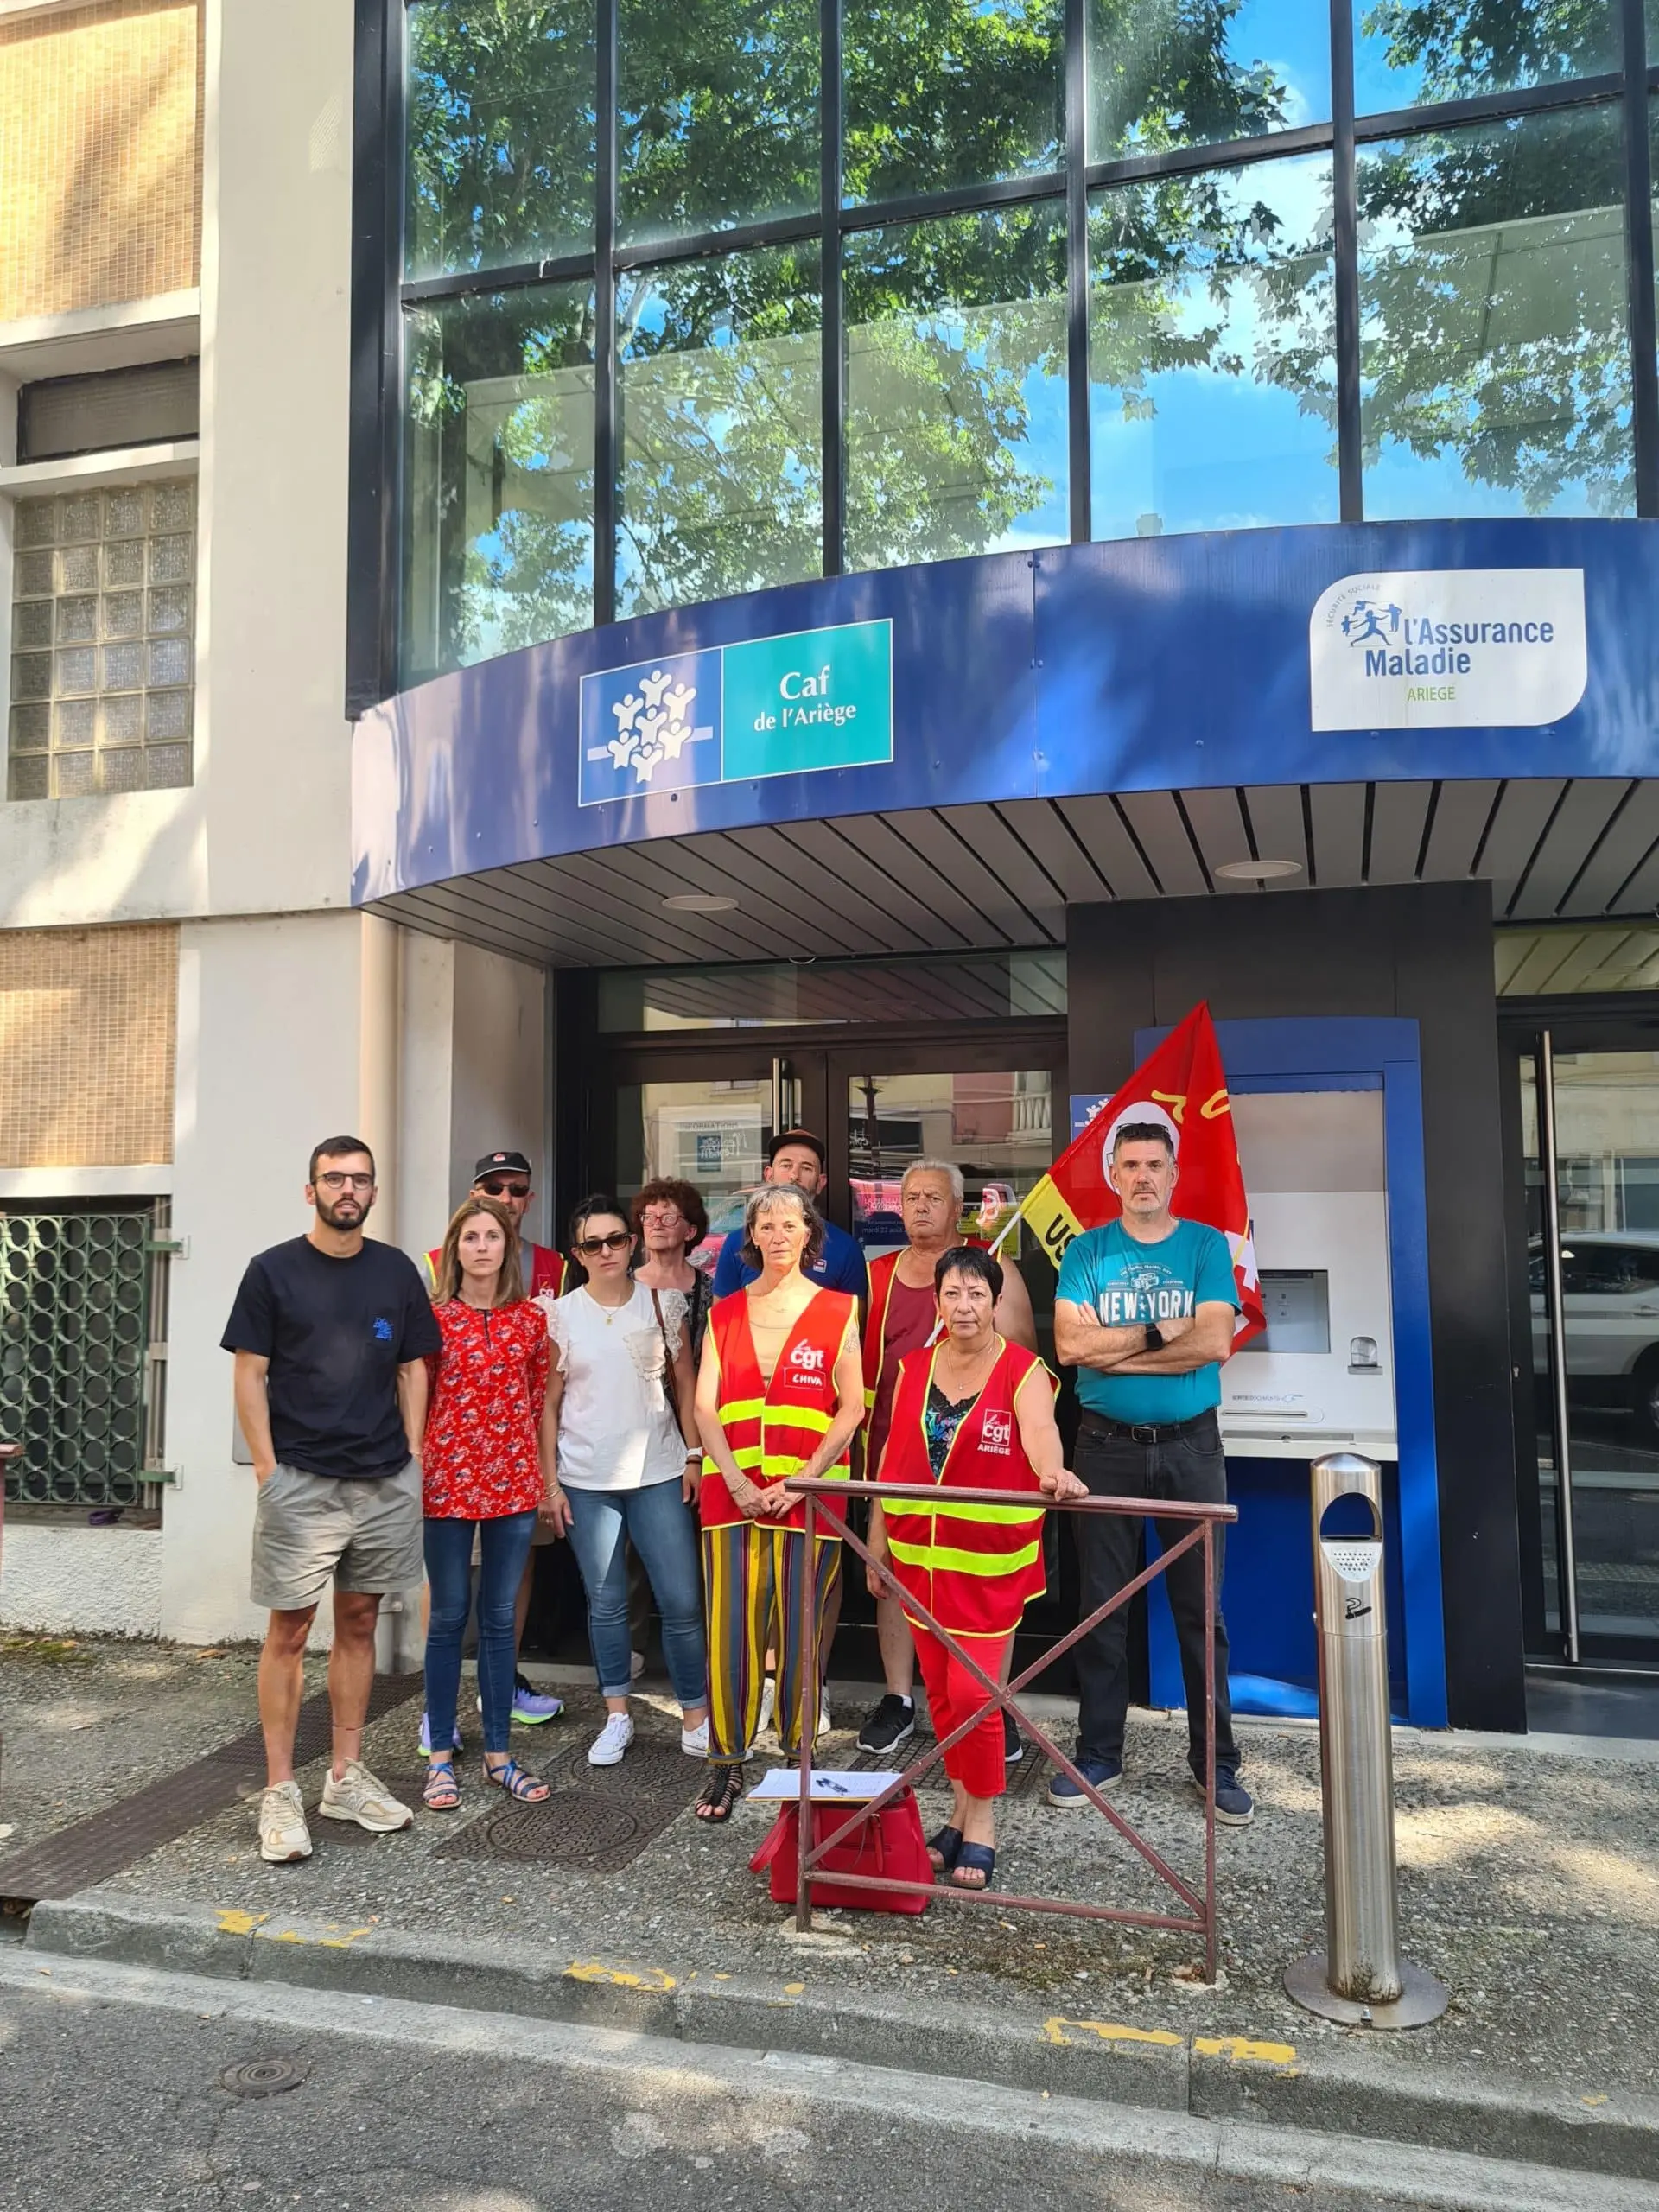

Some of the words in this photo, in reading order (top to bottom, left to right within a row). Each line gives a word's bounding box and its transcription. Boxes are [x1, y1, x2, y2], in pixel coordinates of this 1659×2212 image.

[1404, 617, 1554, 646] l'Assurance
[1365, 647, 1471, 677] Maladie
[779, 664, 831, 700] Caf
[1407, 686, 1456, 702] ARIEGE
[753, 711, 776, 732] de
[782, 702, 857, 727] l'Ariège
[1099, 1291, 1138, 1324] NEW
[1147, 1289, 1195, 1319] YORK
[792, 1373, 823, 1386] CHIVA
